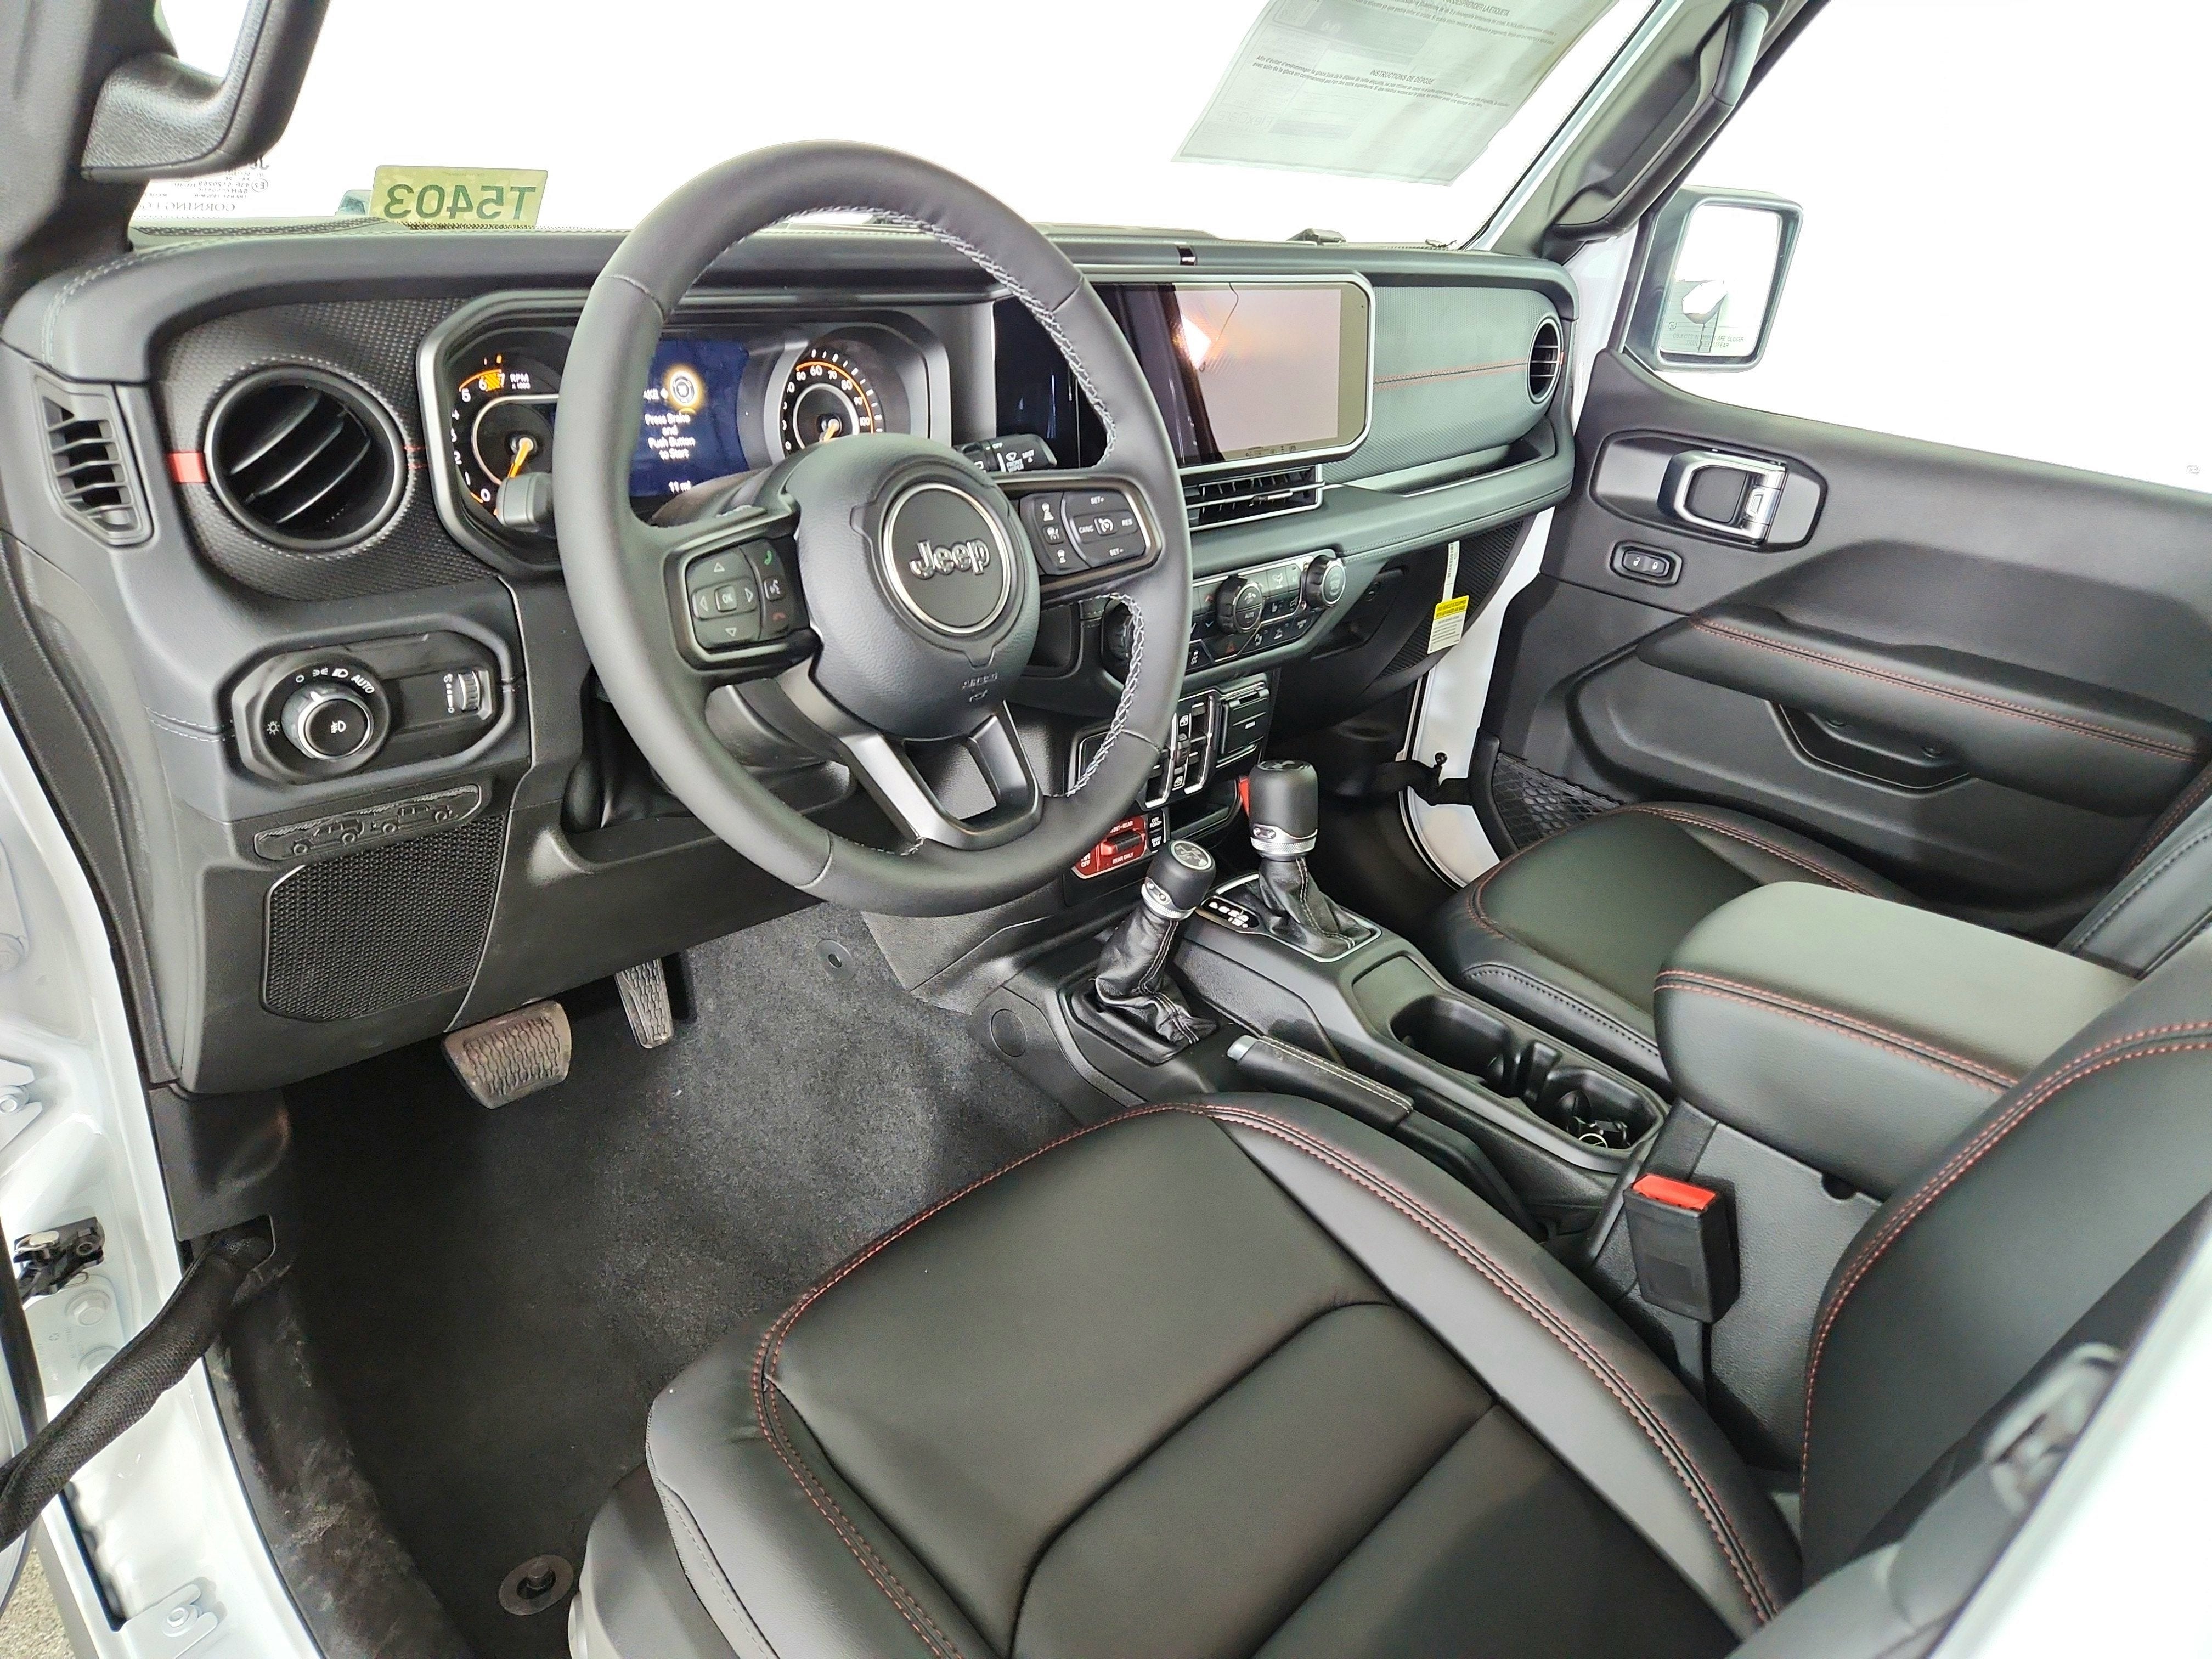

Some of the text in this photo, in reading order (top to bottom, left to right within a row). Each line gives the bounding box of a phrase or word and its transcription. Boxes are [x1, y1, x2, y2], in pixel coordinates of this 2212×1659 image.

[1369, 69, 1407, 81] INSTRUCTIONS
[796, 371, 806, 381] 50
[810, 365, 823, 376] 60
[827, 370, 838, 380] 70
[478, 377, 487, 391] 6
[510, 373, 529, 382] RPM
[841, 379, 853, 390] 80
[461, 388, 471, 403] 5
[853, 396, 863, 405] 90
[452, 408, 460, 420] 4
[645, 411, 691, 426] Press Brake
[859, 416, 871, 427] 100
[662, 424, 679, 437] and
[648, 436, 696, 449] Push Button
[453, 450, 462, 465] 2
[659, 448, 690, 461] to Start
[465, 471, 471, 486] 1
[668, 481, 680, 494] 11
[481, 488, 491, 502] 0
[1122, 518, 1133, 526] RES
[909, 539, 991, 580] Jeep
[721, 594, 733, 603] OK
[351, 674, 375, 694] AUTO
[1112, 852, 1134, 865] REAR ONLY
